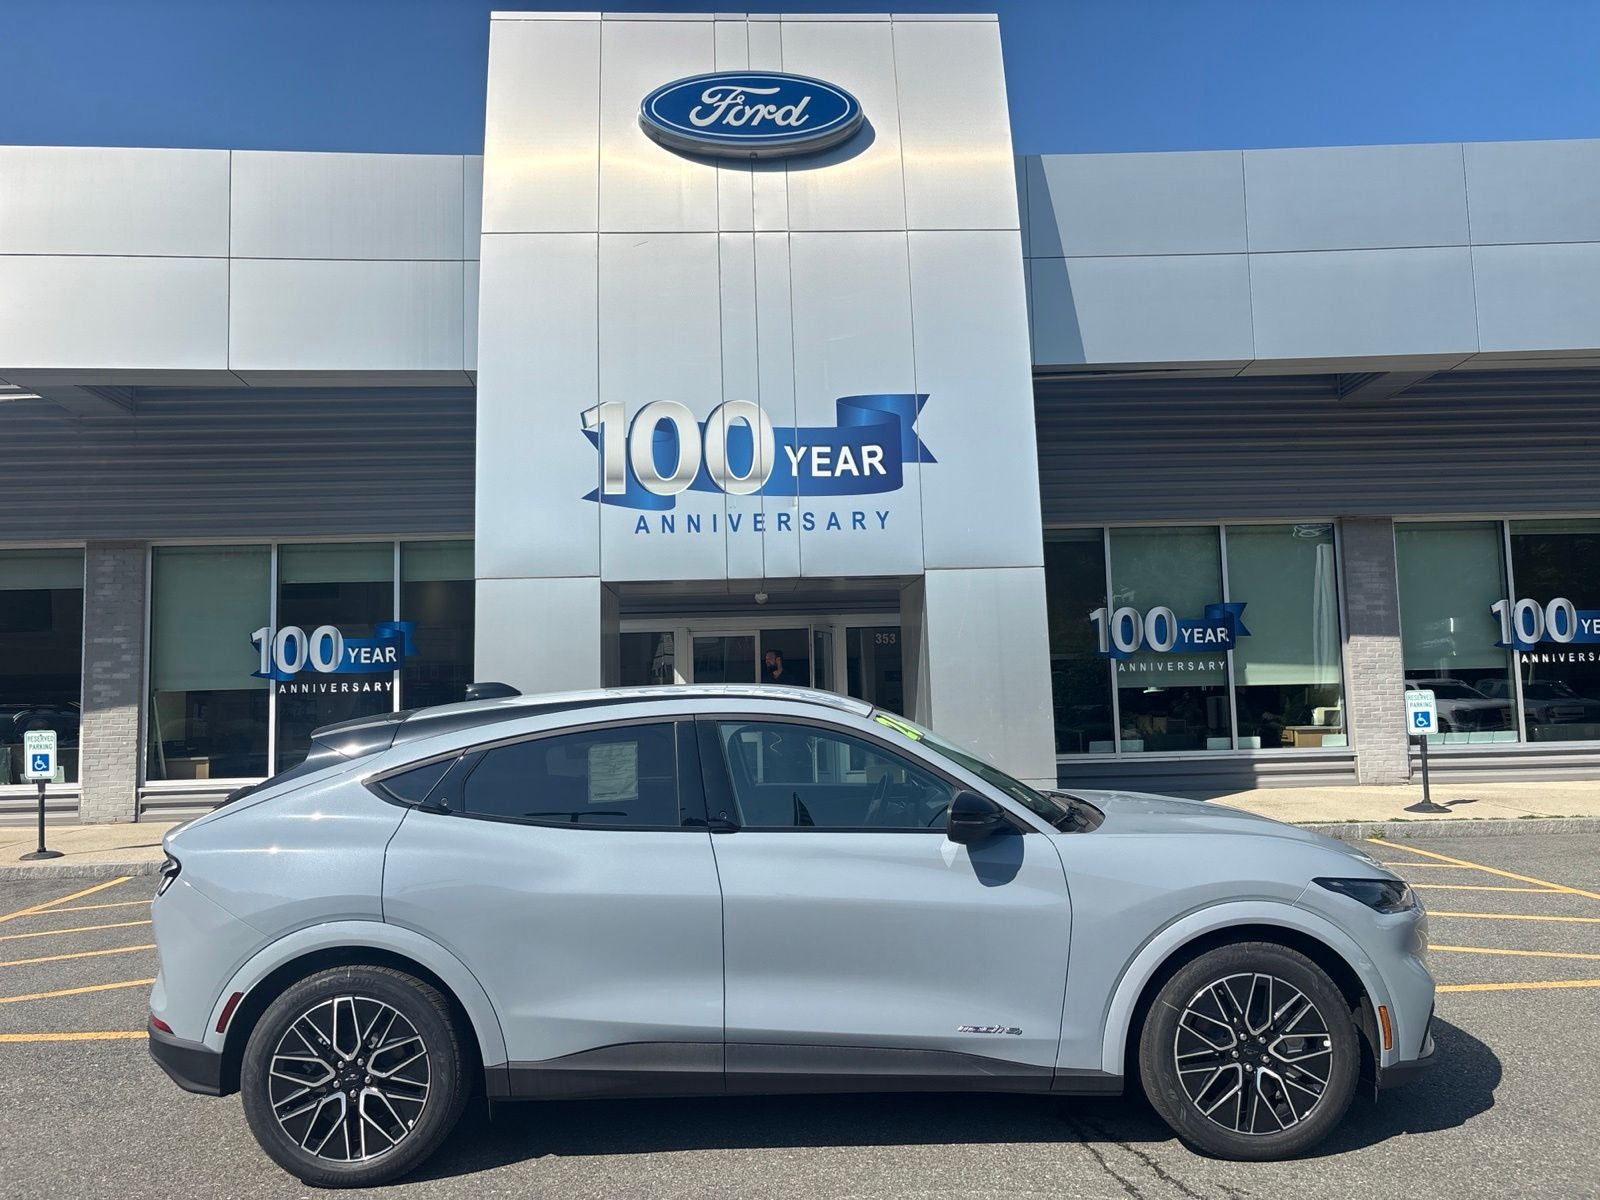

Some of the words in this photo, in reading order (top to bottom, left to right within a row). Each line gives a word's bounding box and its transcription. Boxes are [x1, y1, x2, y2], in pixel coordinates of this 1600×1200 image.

[689, 85, 811, 127] Ford
[580, 399, 775, 496] 100
[784, 444, 888, 477] YEAR
[634, 511, 890, 534] ANNIVERSARY
[875, 633, 896, 644] 353
[1089, 605, 1178, 652] 100
[1181, 627, 1230, 643] YEAR
[1489, 597, 1578, 644] 100
[250, 625, 344, 674] 100
[348, 646, 397, 664] YEAR
[1118, 661, 1226, 672] ANNIVERSARY
[279, 681, 393, 694] ANNIVERSARY
